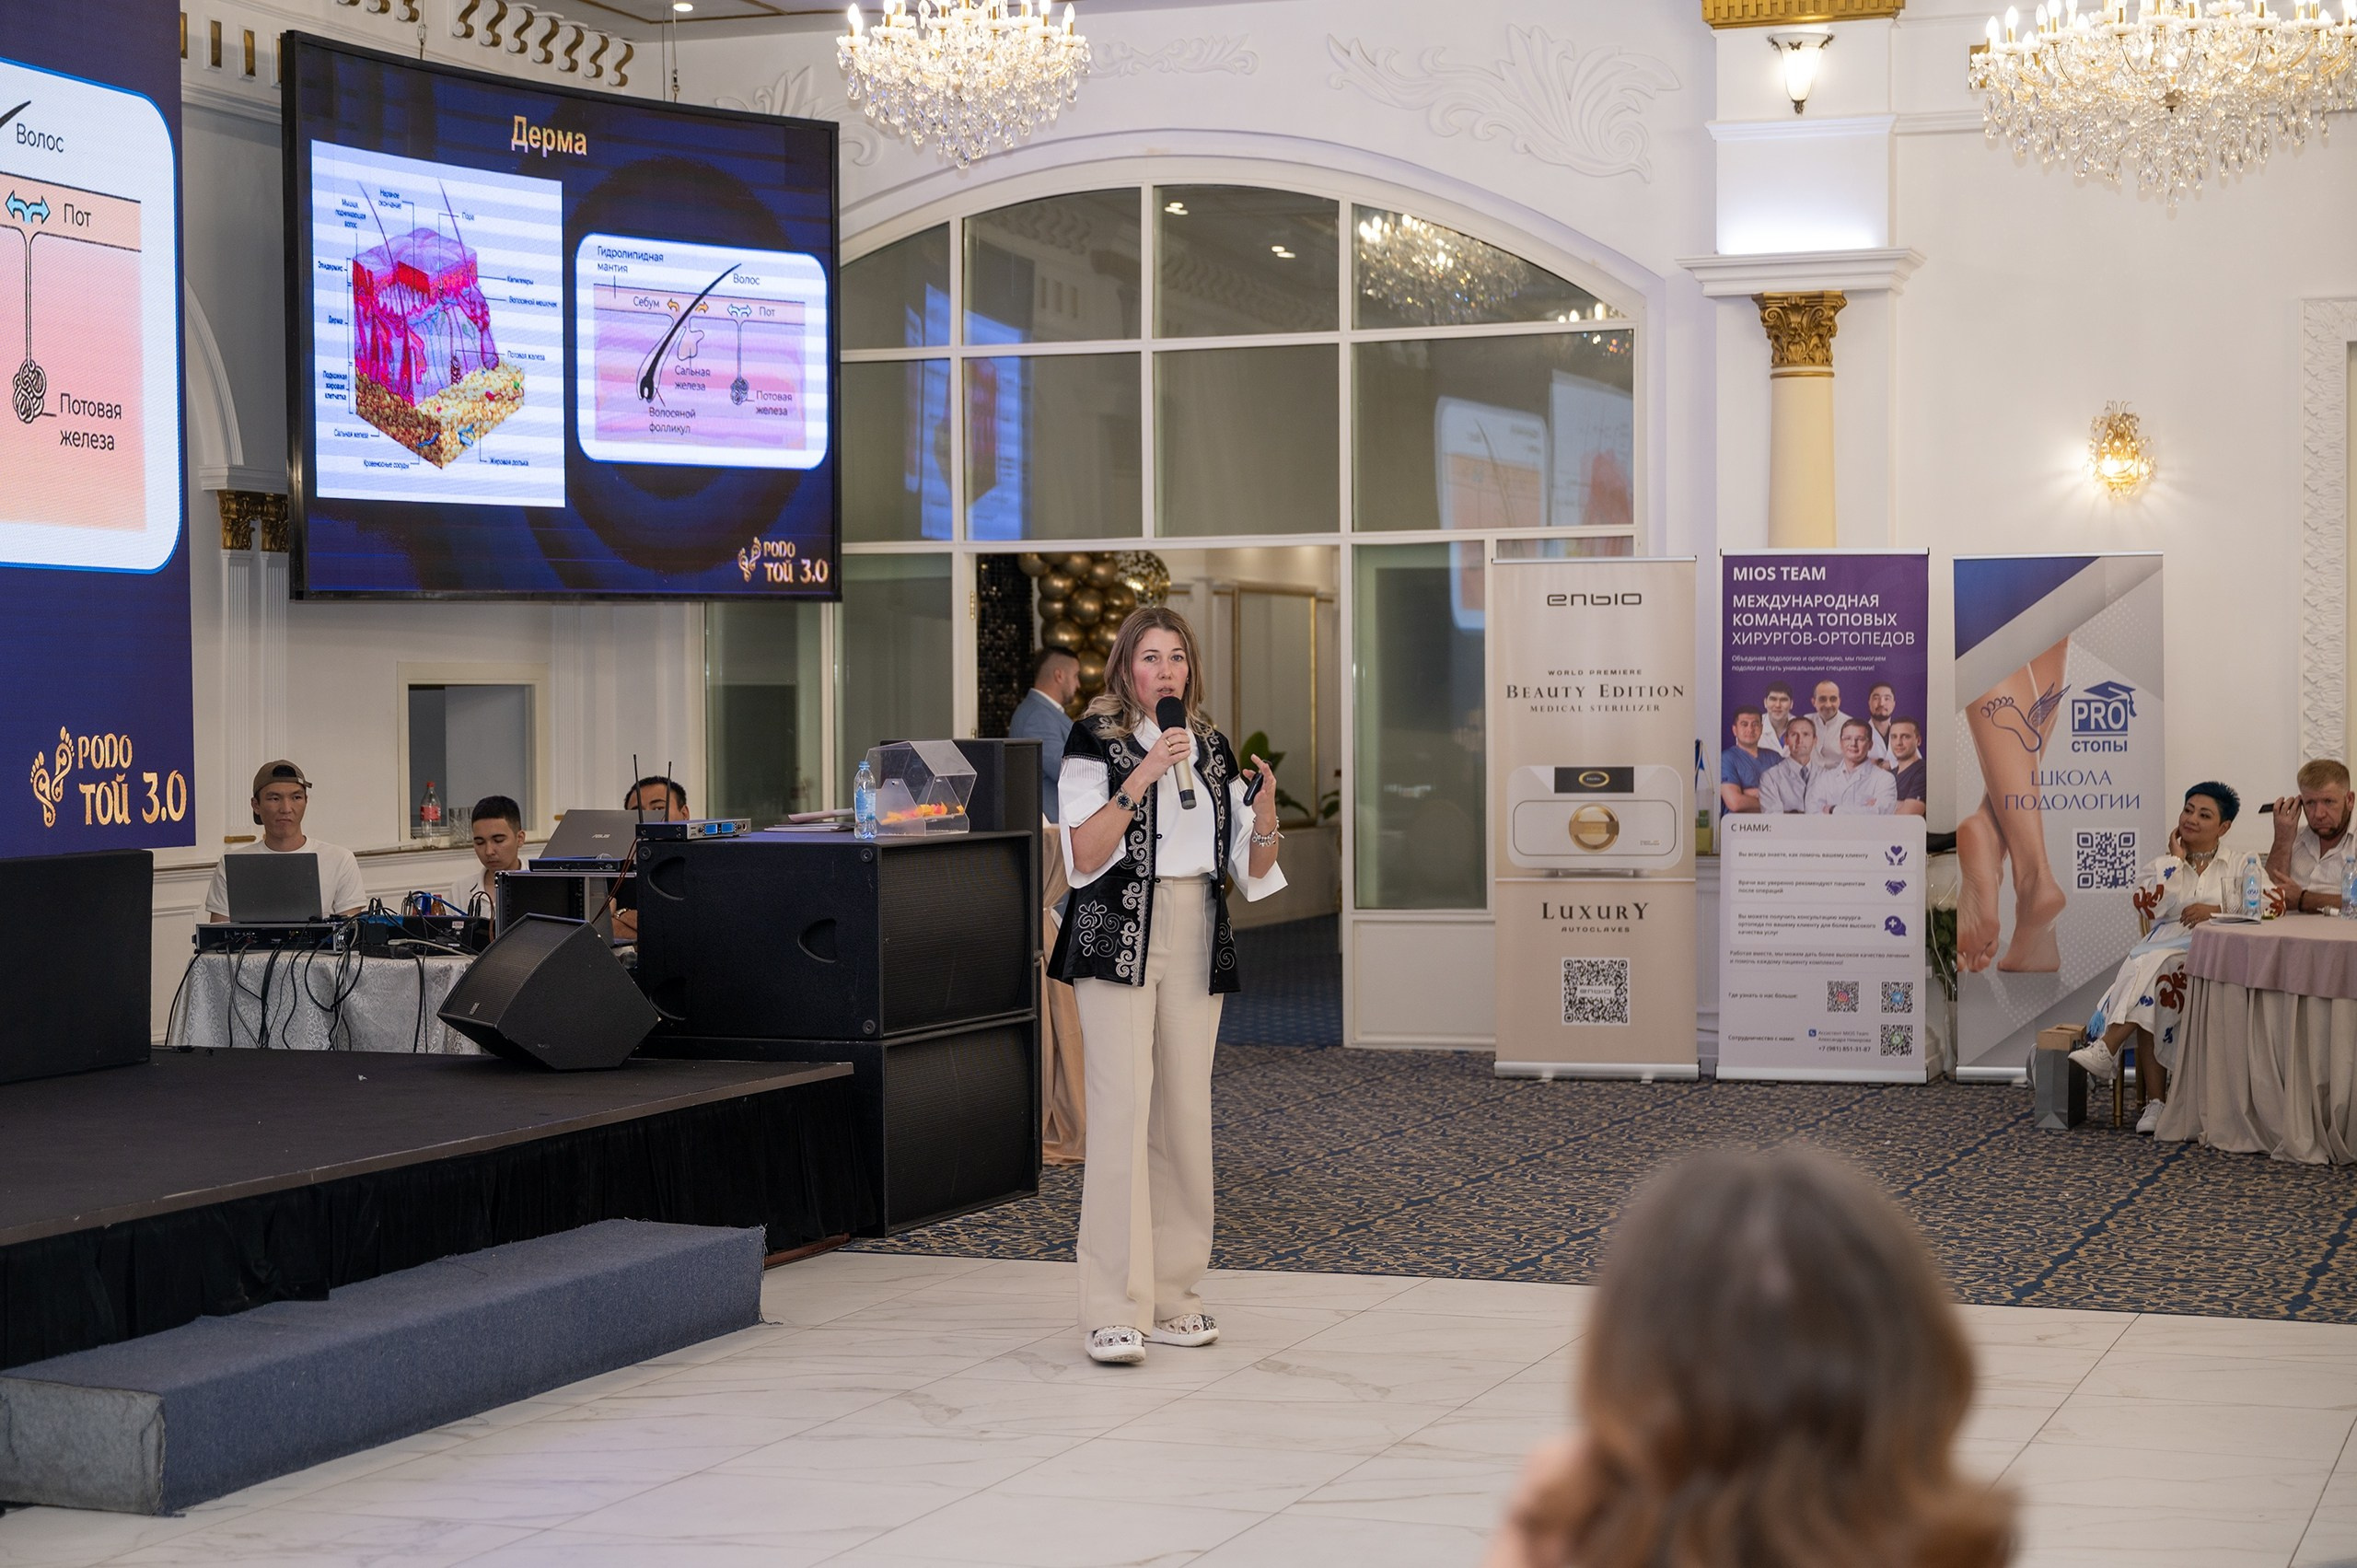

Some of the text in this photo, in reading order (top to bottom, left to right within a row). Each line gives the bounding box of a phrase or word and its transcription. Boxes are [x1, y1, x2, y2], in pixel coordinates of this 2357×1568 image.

[17, 123, 64, 153] Волос
[511, 115, 587, 157] Дерма
[64, 203, 91, 227] Пот
[598, 245, 664, 262] Гидролипидная
[598, 262, 628, 274] мантия
[733, 273, 761, 286] Волос
[633, 296, 660, 310] Себум
[760, 307, 775, 318] Пот
[675, 366, 711, 377] Сальная
[675, 380, 706, 391] железа
[756, 390, 793, 402] Потовая
[60, 393, 122, 421] Потовая
[649, 406, 696, 419] Волосяной
[756, 406, 788, 416] железа
[649, 422, 691, 434] фолликул
[60, 430, 115, 451] железа
[763, 540, 796, 558] PODO
[799, 558, 829, 584] 3.0
[1733, 566, 1827, 582] MIOS TEAM
[1733, 594, 1879, 610] МЕЖДУНАРОДНАЯ
[1733, 612, 1898, 630] КОМАНДА ТОПОВЫХ
[1732, 632, 1915, 647] ХИРУРГОВ-ОРТОПЕДОВ
[1731, 655, 1767, 663] Объединяя
[1548, 668, 1585, 677] WORLD
[1826, 664, 1875, 672] специалистами!
[1529, 704, 1661, 713] MEDICAL STERILIZER
[2073, 701, 2127, 730] PRO
[77, 733, 134, 770] PODO
[2030, 769, 2112, 786] ШКОЛА
[142, 769, 187, 824] 3.0
[2004, 794, 2141, 811] ПОДОЛОГИИ
[1730, 823, 1771, 833] С НАМИ:
